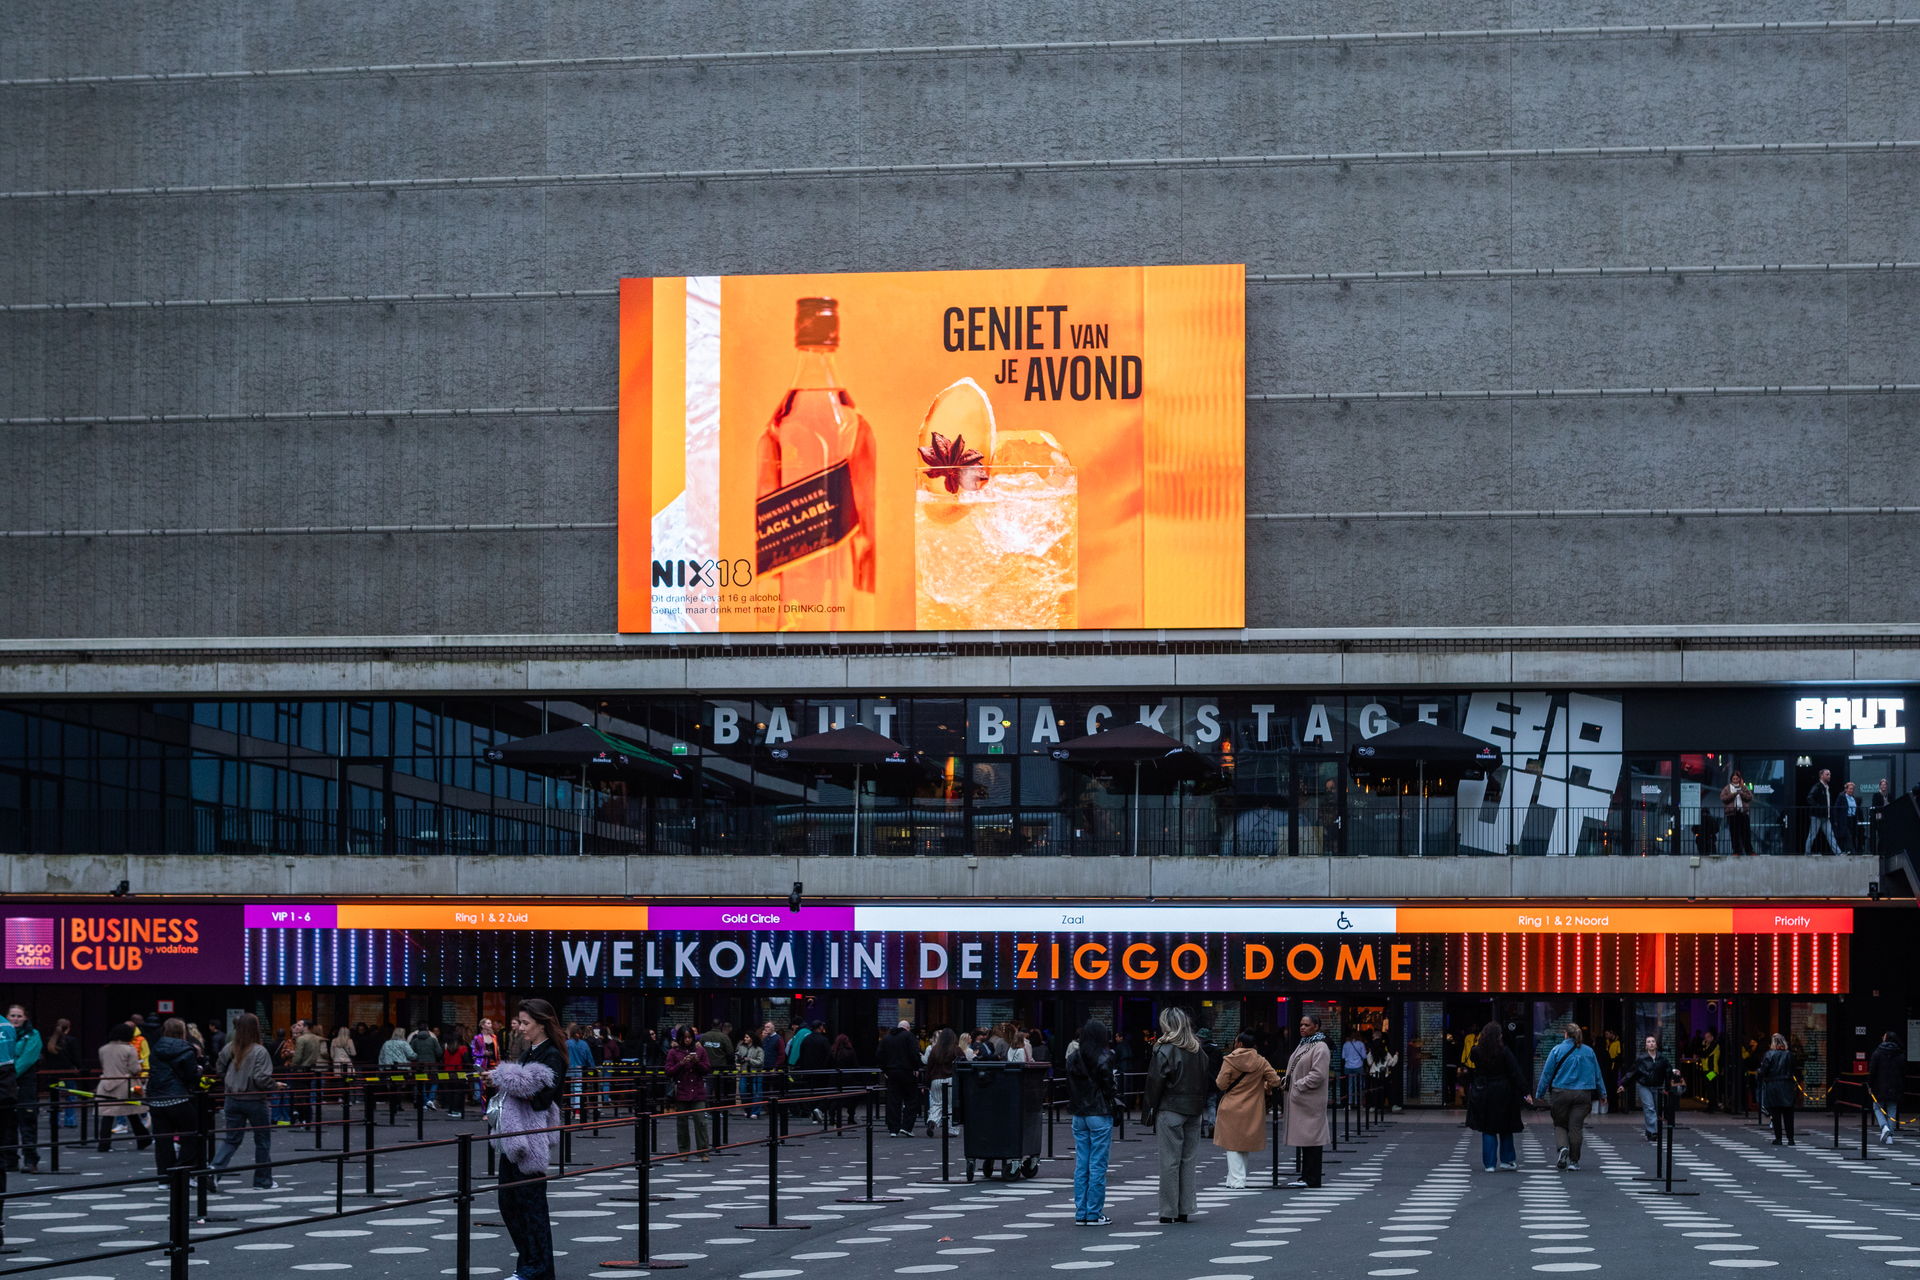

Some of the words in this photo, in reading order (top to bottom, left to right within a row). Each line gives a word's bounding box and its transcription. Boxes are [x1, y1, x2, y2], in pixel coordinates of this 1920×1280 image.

[943, 305, 1068, 352] GENIET
[1070, 324, 1108, 349] VAN
[994, 359, 1018, 384] JE
[1024, 355, 1143, 401] AVOND
[756, 518, 791, 540] LACK
[651, 594, 663, 602] Dit
[666, 594, 698, 604] drankje
[728, 594, 739, 602] 16
[741, 595, 747, 604] g
[710, 605, 732, 614] drink
[734, 606, 751, 614] met
[753, 605, 776, 614] mate
[271, 911, 288, 922] VIP
[290, 911, 295, 922] 1
[304, 911, 311, 922] 6
[455, 912, 477, 924] Ring
[480, 912, 484, 922] 1
[488, 912, 497, 922] &
[499, 912, 506, 922] 2
[507, 912, 529, 923] Zuid
[721, 913, 748, 924] Gold
[750, 913, 780, 924] Circle
[1061, 915, 1084, 925] Zaal
[1518, 915, 1542, 928] Ring
[1545, 915, 1550, 925] 1
[1554, 915, 1563, 925] &
[1565, 915, 1572, 925] 2
[1574, 915, 1609, 926] Noord
[1774, 915, 1811, 928] Priority
[71, 917, 199, 943] BUSINESS
[15, 944, 52, 957] ziggo
[15, 954, 52, 967] dome
[71, 945, 144, 971] CLUB
[144, 946, 154, 955] by
[155, 944, 199, 954] vodafone
[562, 940, 796, 979] WELKOM
[830, 941, 882, 979] IN
[919, 942, 983, 979] DE
[1016, 942, 1208, 981] ZIGGO
[1245, 943, 1412, 981] DOME
